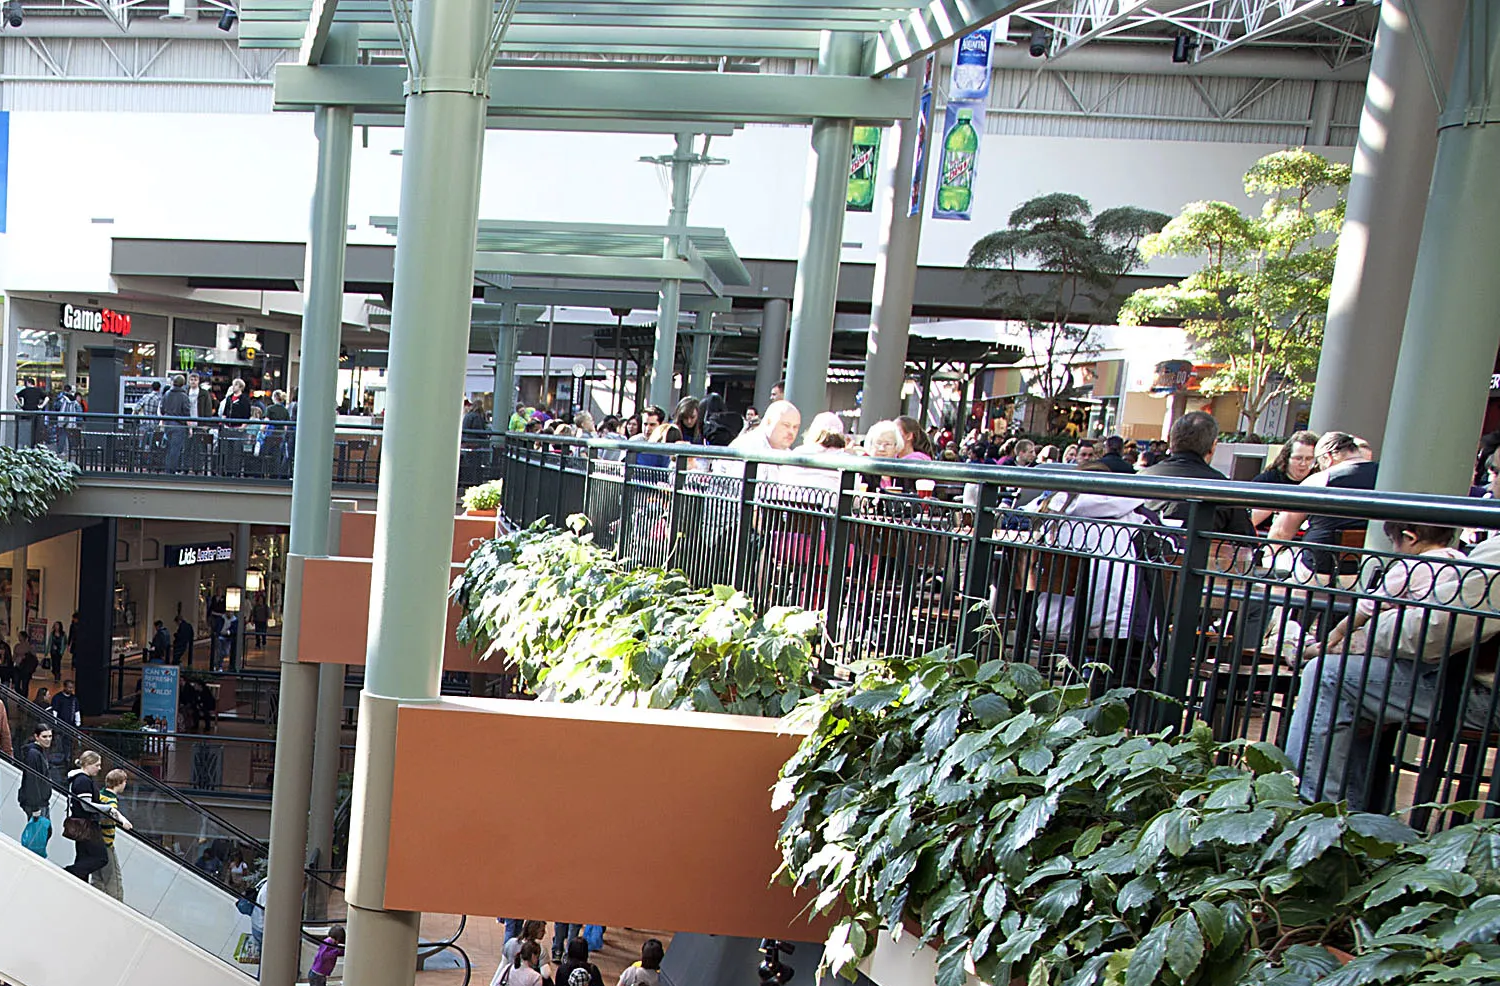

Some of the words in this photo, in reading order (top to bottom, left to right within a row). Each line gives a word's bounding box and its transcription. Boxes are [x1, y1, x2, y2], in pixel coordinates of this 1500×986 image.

[63, 303, 132, 336] GameStop
[179, 547, 196, 565] Lids
[197, 547, 215, 562] Locker
[216, 546, 232, 560] Room
